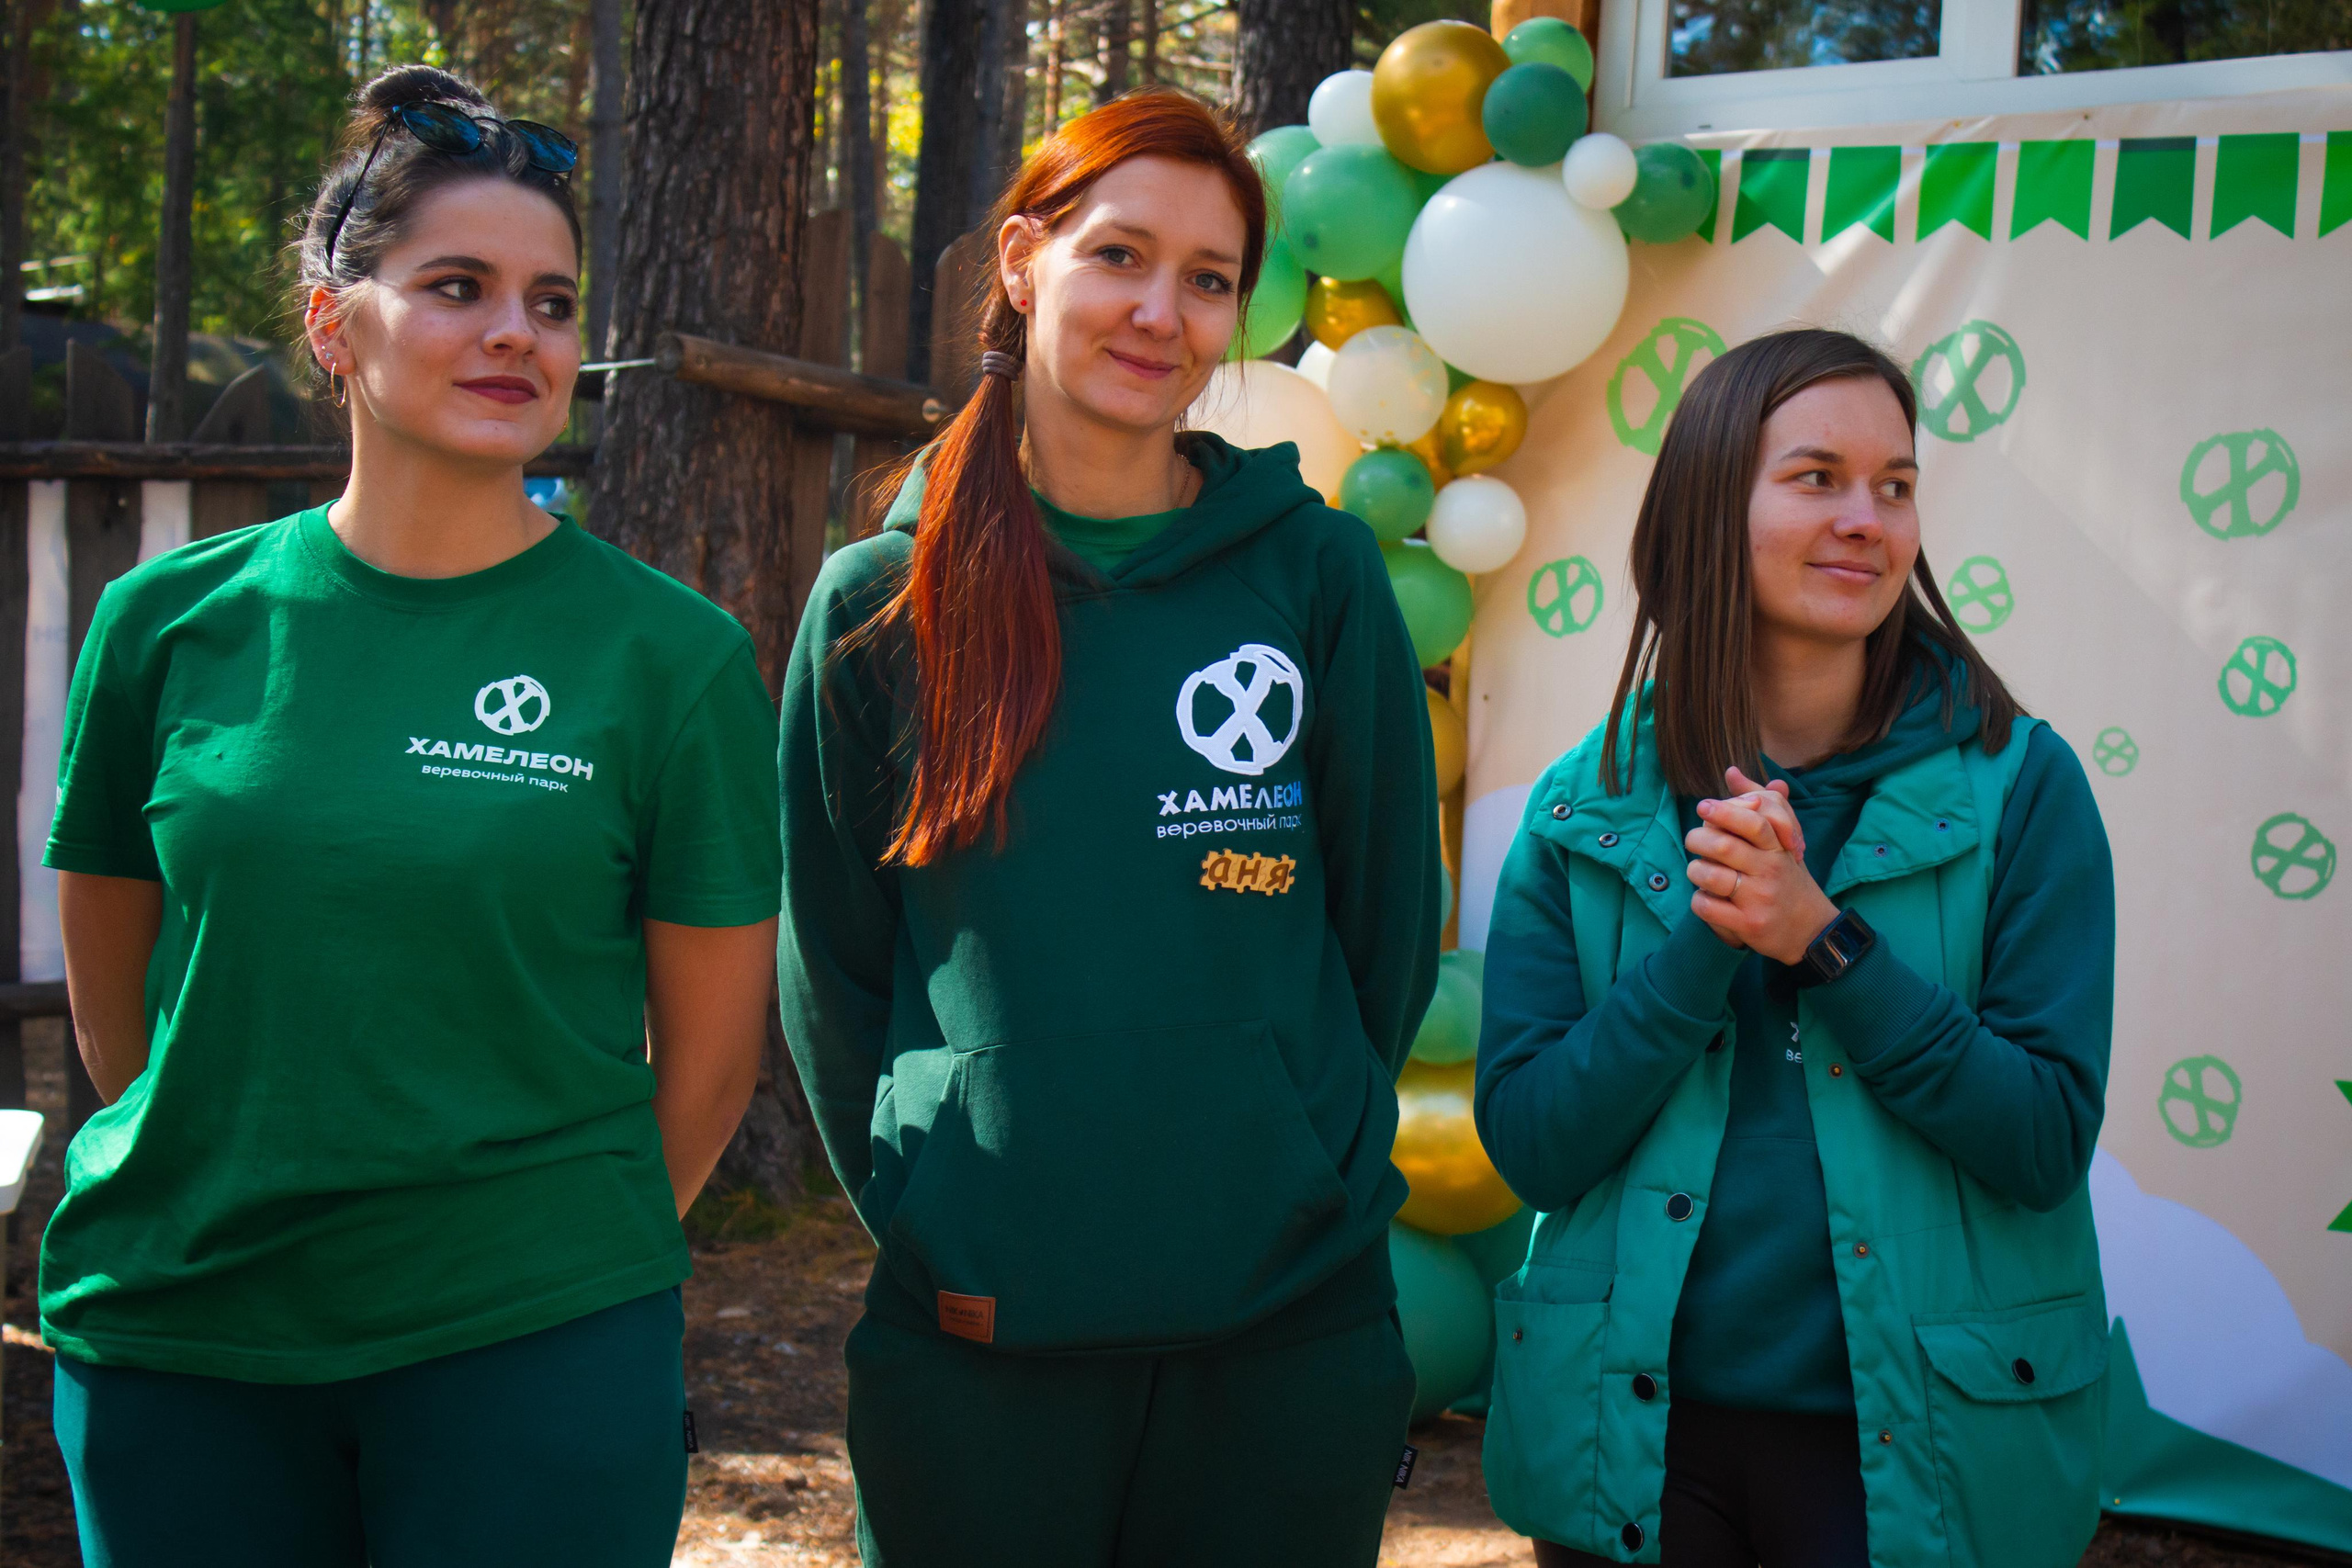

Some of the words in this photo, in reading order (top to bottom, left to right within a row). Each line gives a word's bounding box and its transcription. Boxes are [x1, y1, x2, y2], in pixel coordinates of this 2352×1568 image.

[404, 737, 594, 781] ХАМЕЛЕОН
[421, 764, 525, 784] веревочный
[528, 776, 569, 793] парк
[1157, 781, 1303, 817] ХАМЕЛЕОН
[1157, 813, 1277, 839] веревочный
[1279, 813, 1303, 831] парк
[1208, 856, 1290, 889] аня
